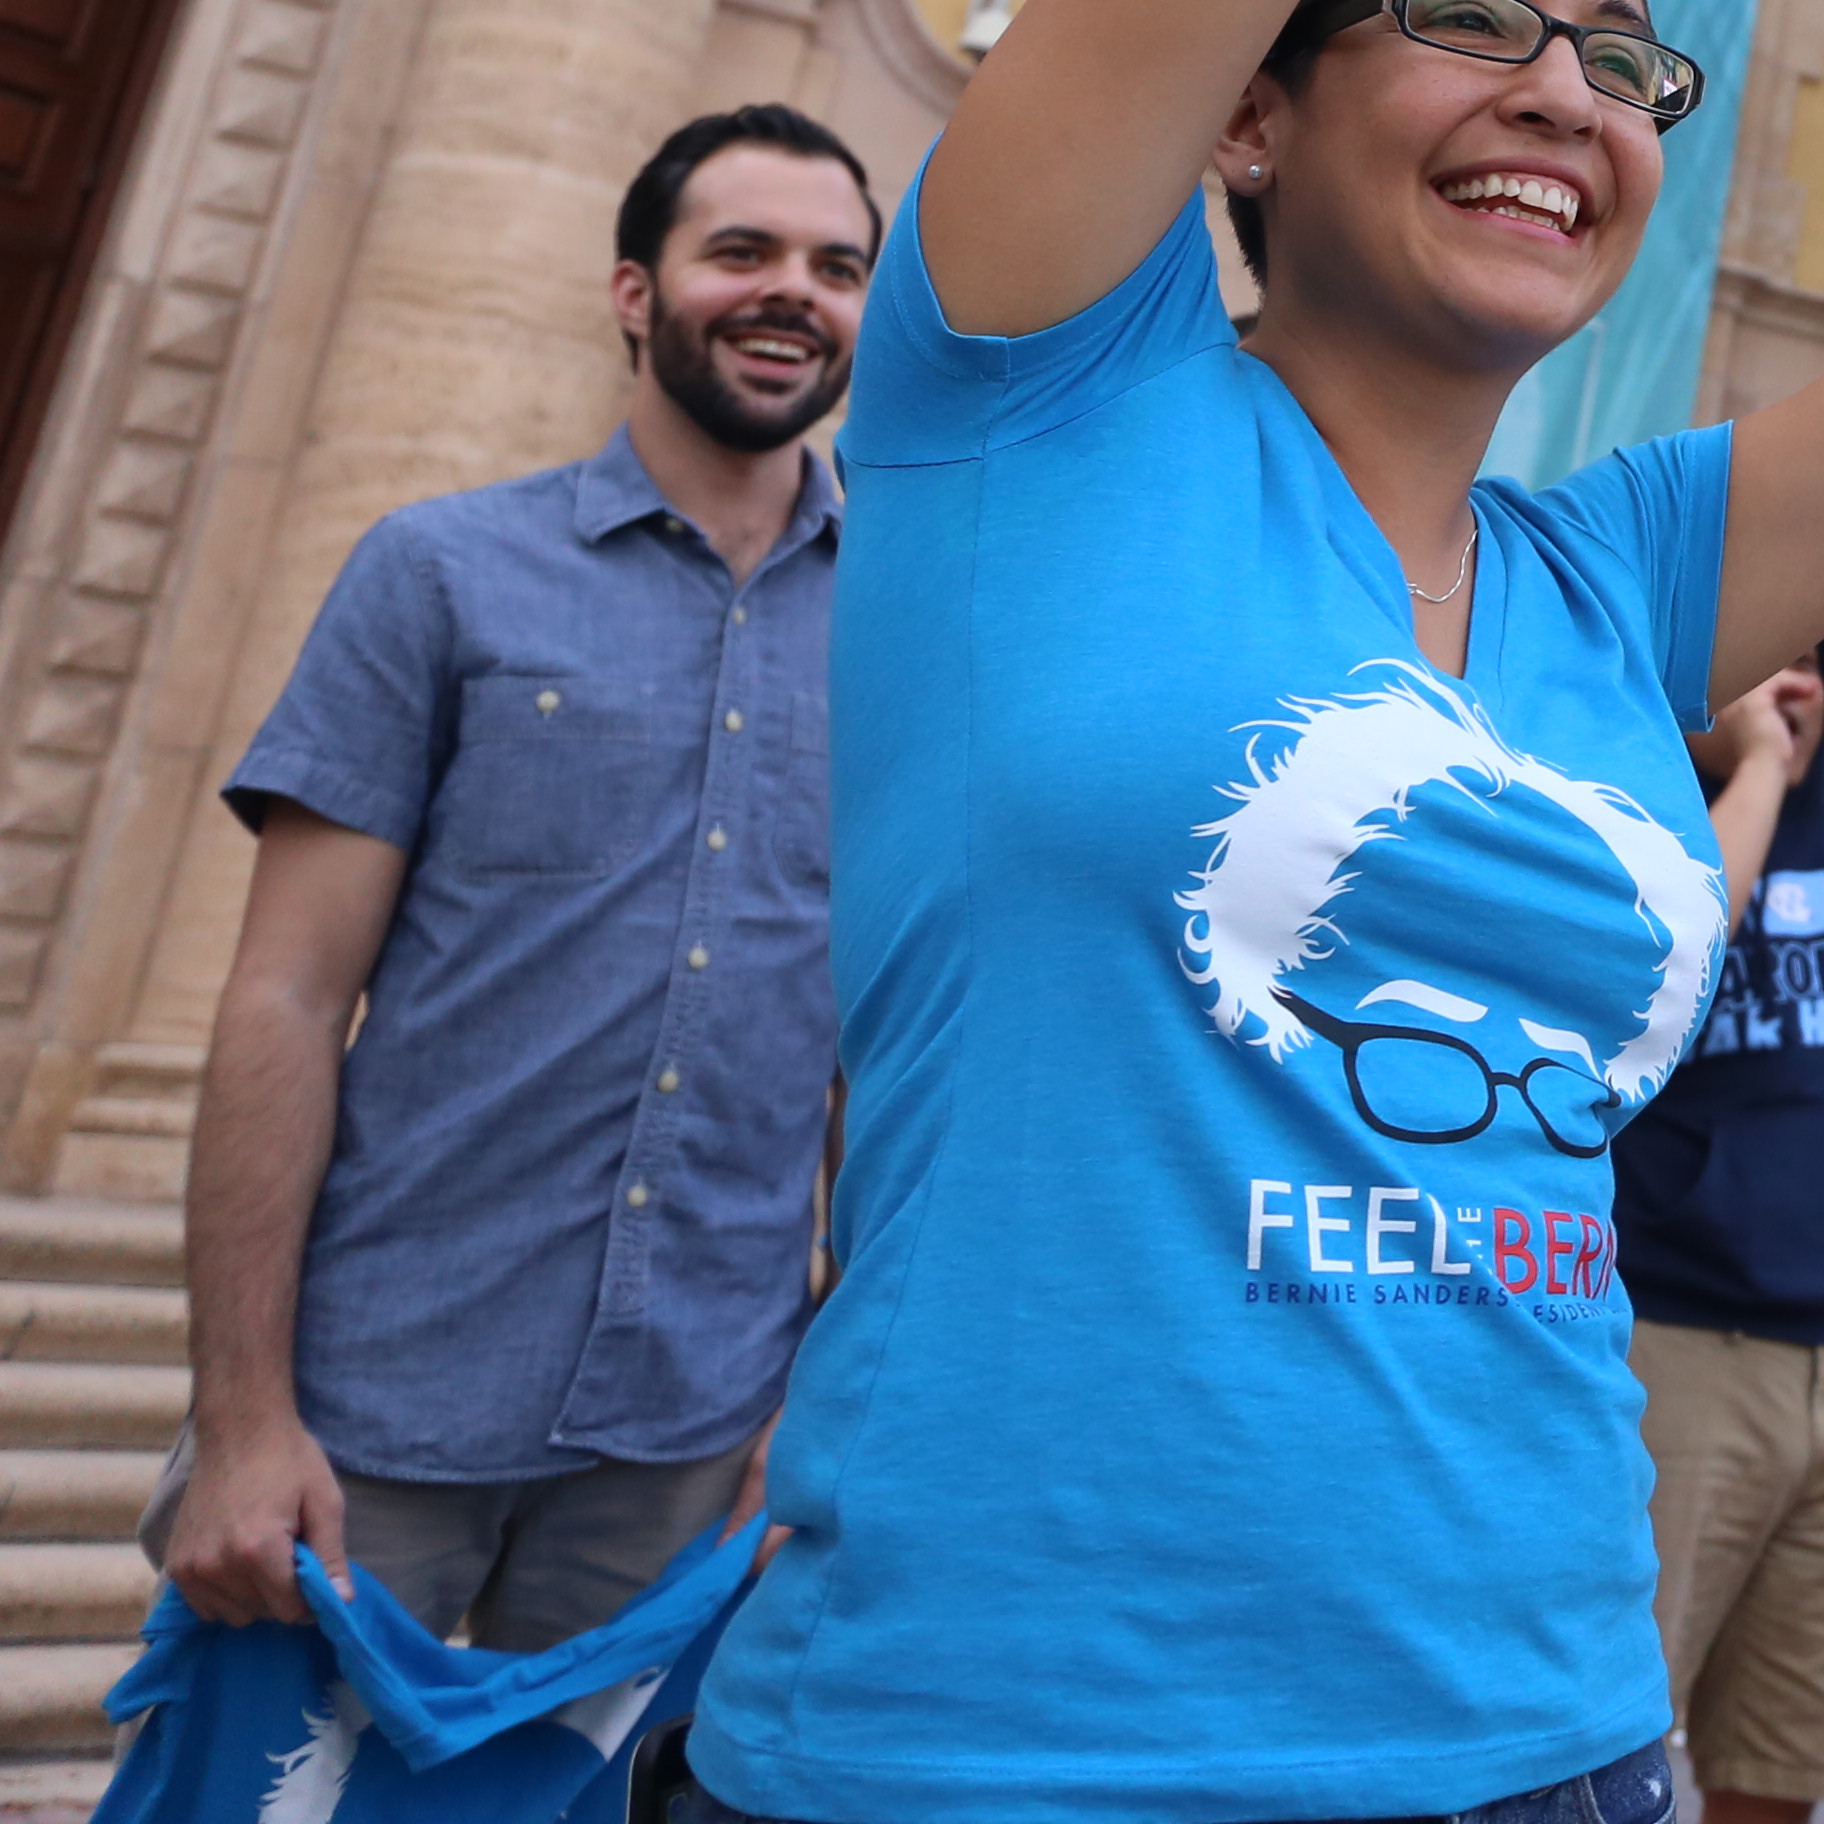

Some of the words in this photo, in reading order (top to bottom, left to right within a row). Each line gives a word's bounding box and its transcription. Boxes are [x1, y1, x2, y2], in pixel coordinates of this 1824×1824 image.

[1246, 1178, 1473, 1276] FEEL
[1245, 1281, 1357, 1304] BERNIE
[1373, 1284, 1510, 1308] SANDERS
